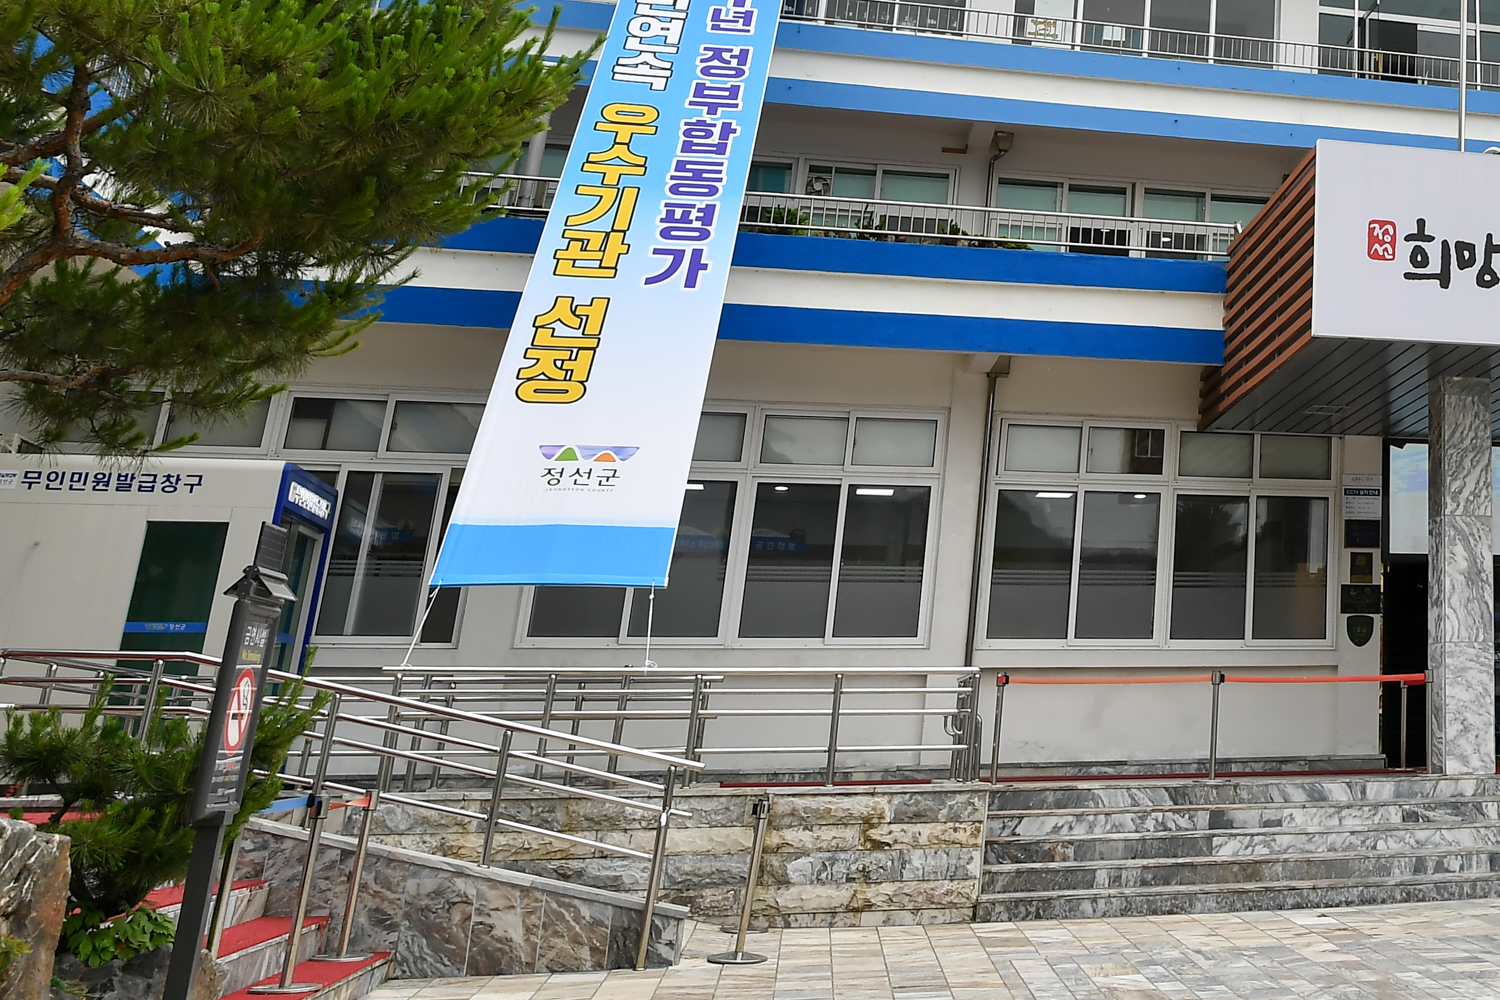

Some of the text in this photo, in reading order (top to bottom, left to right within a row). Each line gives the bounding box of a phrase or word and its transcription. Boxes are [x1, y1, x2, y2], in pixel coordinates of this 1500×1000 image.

[552, 102, 660, 278] 우수기관
[642, 45, 756, 290] 정부합동평가
[514, 296, 610, 404] 선정
[21, 470, 204, 494] 무인민원발급창구
[541, 467, 620, 486] 정선군
